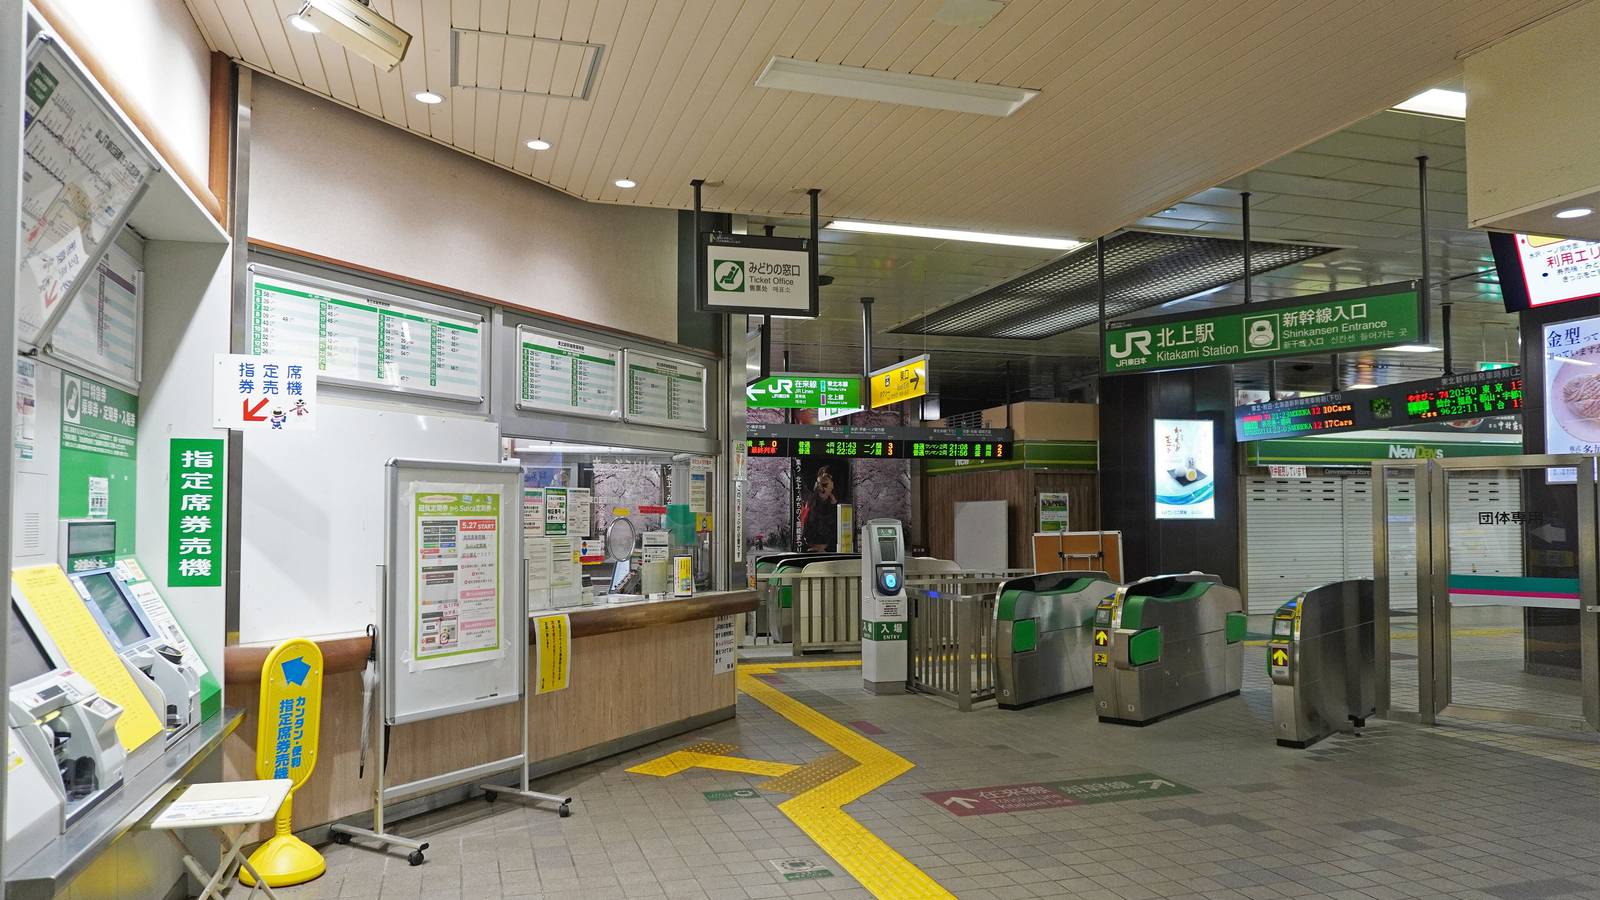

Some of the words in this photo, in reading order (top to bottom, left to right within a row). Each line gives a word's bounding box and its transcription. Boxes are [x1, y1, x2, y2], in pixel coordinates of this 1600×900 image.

[748, 262, 801, 276] みどりの窓口
[749, 275, 771, 284] Ticket
[772, 277, 794, 285] Office
[1282, 303, 1367, 328] 新幹線入口
[1156, 322, 1215, 348] 北上駅
[1282, 326, 1339, 340] Shinkansen
[1341, 320, 1388, 333] Entrance
[1110, 330, 1152, 359] JR
[1156, 349, 1200, 362] Kitakami
[1202, 344, 1239, 357] Station
[1116, 357, 1148, 368] JR東日本
[238, 362, 303, 380] 指定席
[238, 378, 303, 396] 券売機
[768, 379, 793, 394] JR
[794, 380, 817, 389] 在来線
[1449, 387, 1477, 398] 20:50
[1482, 383, 1503, 393] 東京
[1311, 407, 1321, 415] 12
[1322, 404, 1352, 414] 10Cars
[1450, 403, 1478, 415] 22:11
[1484, 400, 1505, 411] 仙台
[1312, 421, 1322, 429] 12
[1323, 419, 1353, 429] 17Cars
[177, 449, 214, 578] 指定席券売機
[462, 521, 477, 529] 5.27
[880, 623, 903, 634] 入場
